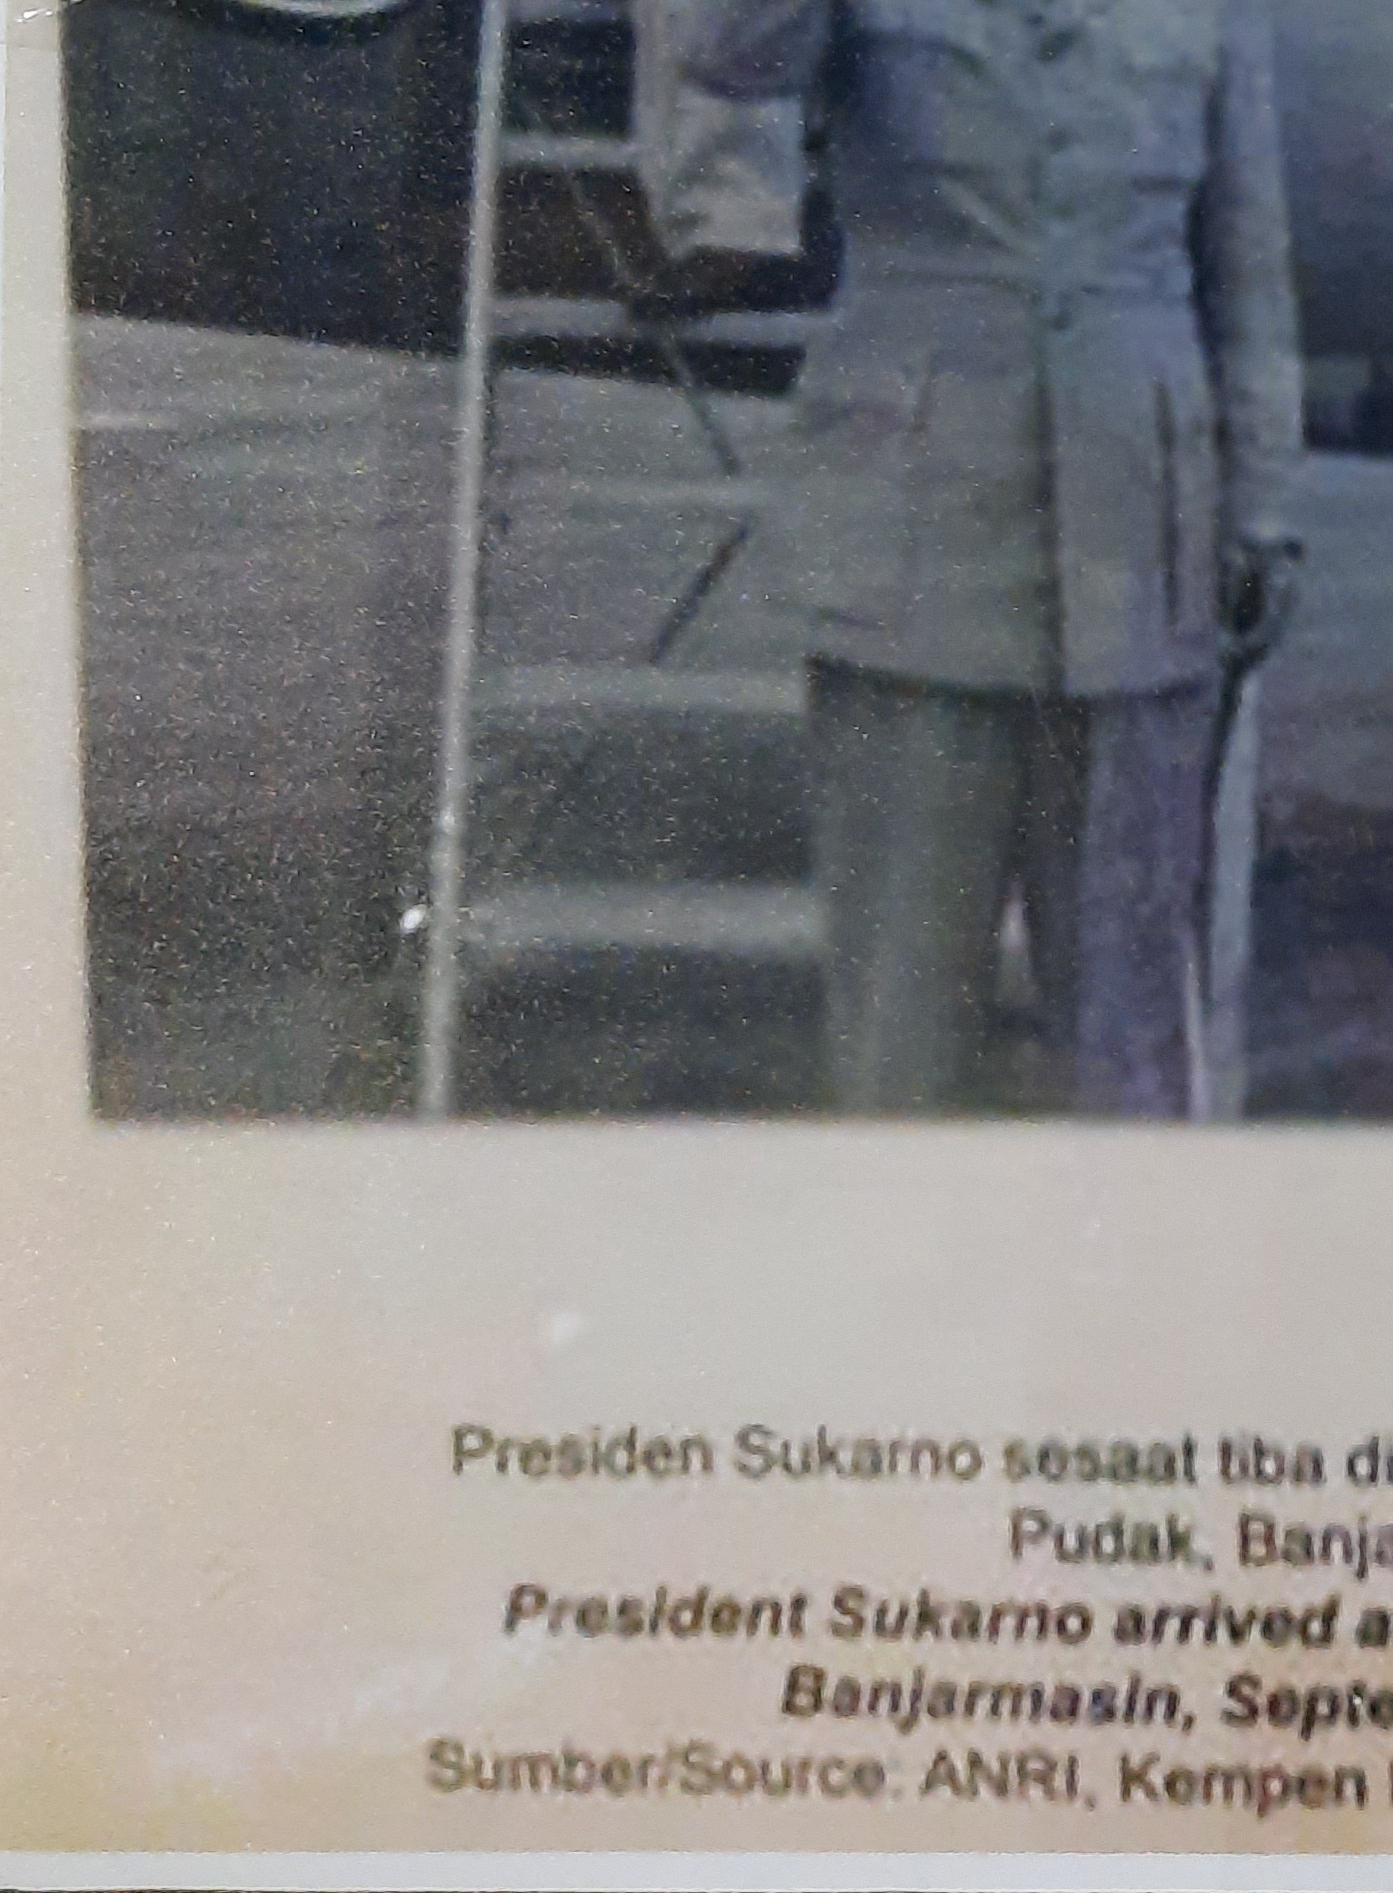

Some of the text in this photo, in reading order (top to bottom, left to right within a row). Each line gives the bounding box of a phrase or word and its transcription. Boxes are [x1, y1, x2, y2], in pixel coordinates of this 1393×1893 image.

[449, 1423, 715, 1482] Presiden
[732, 1423, 985, 1484] Sukarno
[1001, 1432, 1199, 1486] sesaat
[1217, 1434, 1327, 1487] tiba
[1009, 1507, 1215, 1572] Pudak,
[502, 1583, 809, 1641] President
[828, 1585, 1094, 1647] Sukarno
[1112, 1594, 1342, 1650] arrived
[780, 1664, 1197, 1735] Banjarmasin,
[918, 1748, 1099, 1813] ANRI,
[1119, 1753, 1370, 1822] Kempen
